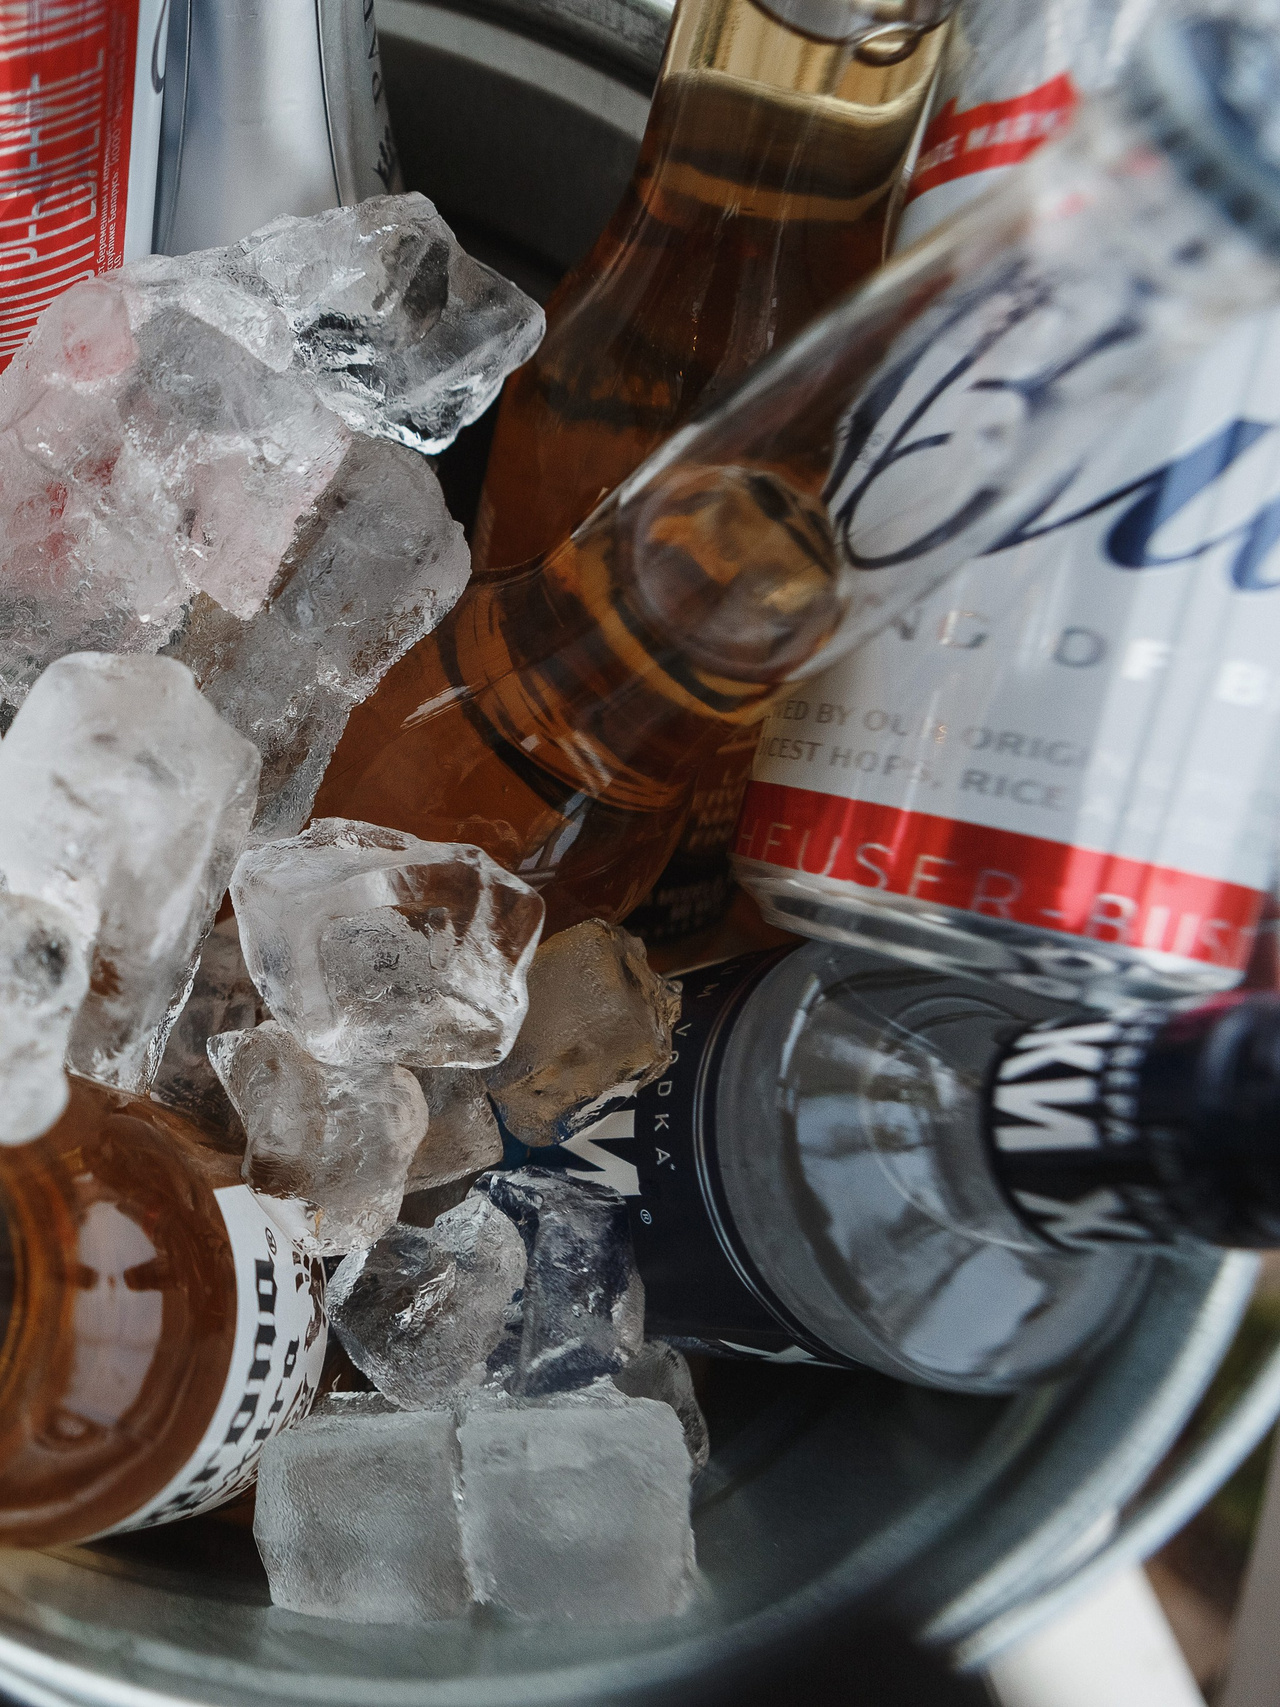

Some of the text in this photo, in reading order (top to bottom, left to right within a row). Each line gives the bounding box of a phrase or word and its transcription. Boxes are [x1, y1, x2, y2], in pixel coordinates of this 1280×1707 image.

[107, 171, 120, 222] Беларусь:
[96, 194, 109, 263] беременным
[815, 702, 853, 726] BY
[657, 1021, 692, 1167] VODKA
